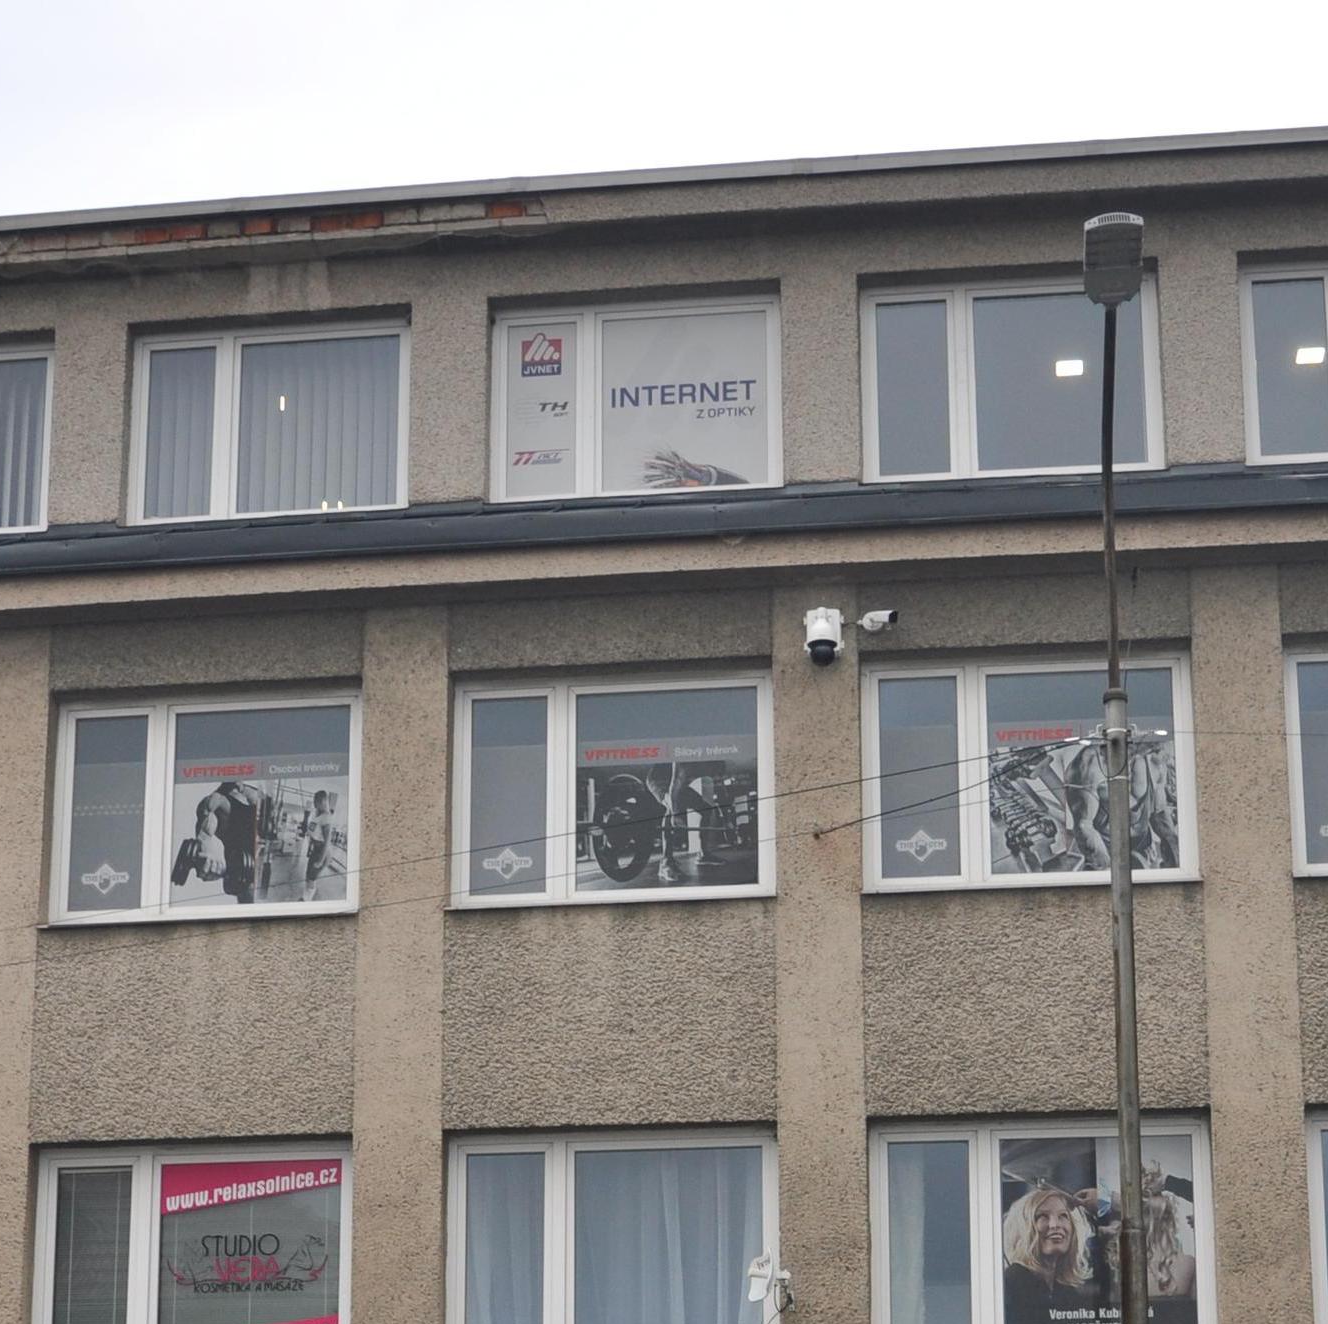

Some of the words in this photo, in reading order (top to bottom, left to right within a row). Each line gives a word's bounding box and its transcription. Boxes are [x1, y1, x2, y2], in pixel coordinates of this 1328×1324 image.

[523, 364, 560, 375] JVNET
[611, 379, 757, 408] INTERNET
[696, 409, 705, 419] Z
[707, 406, 756, 418] OPTIKY
[166, 1167, 338, 1212] www.relaxsolnice.cz
[201, 1233, 281, 1257] STUDIO
[1049, 1308, 1096, 1320] Veronika
